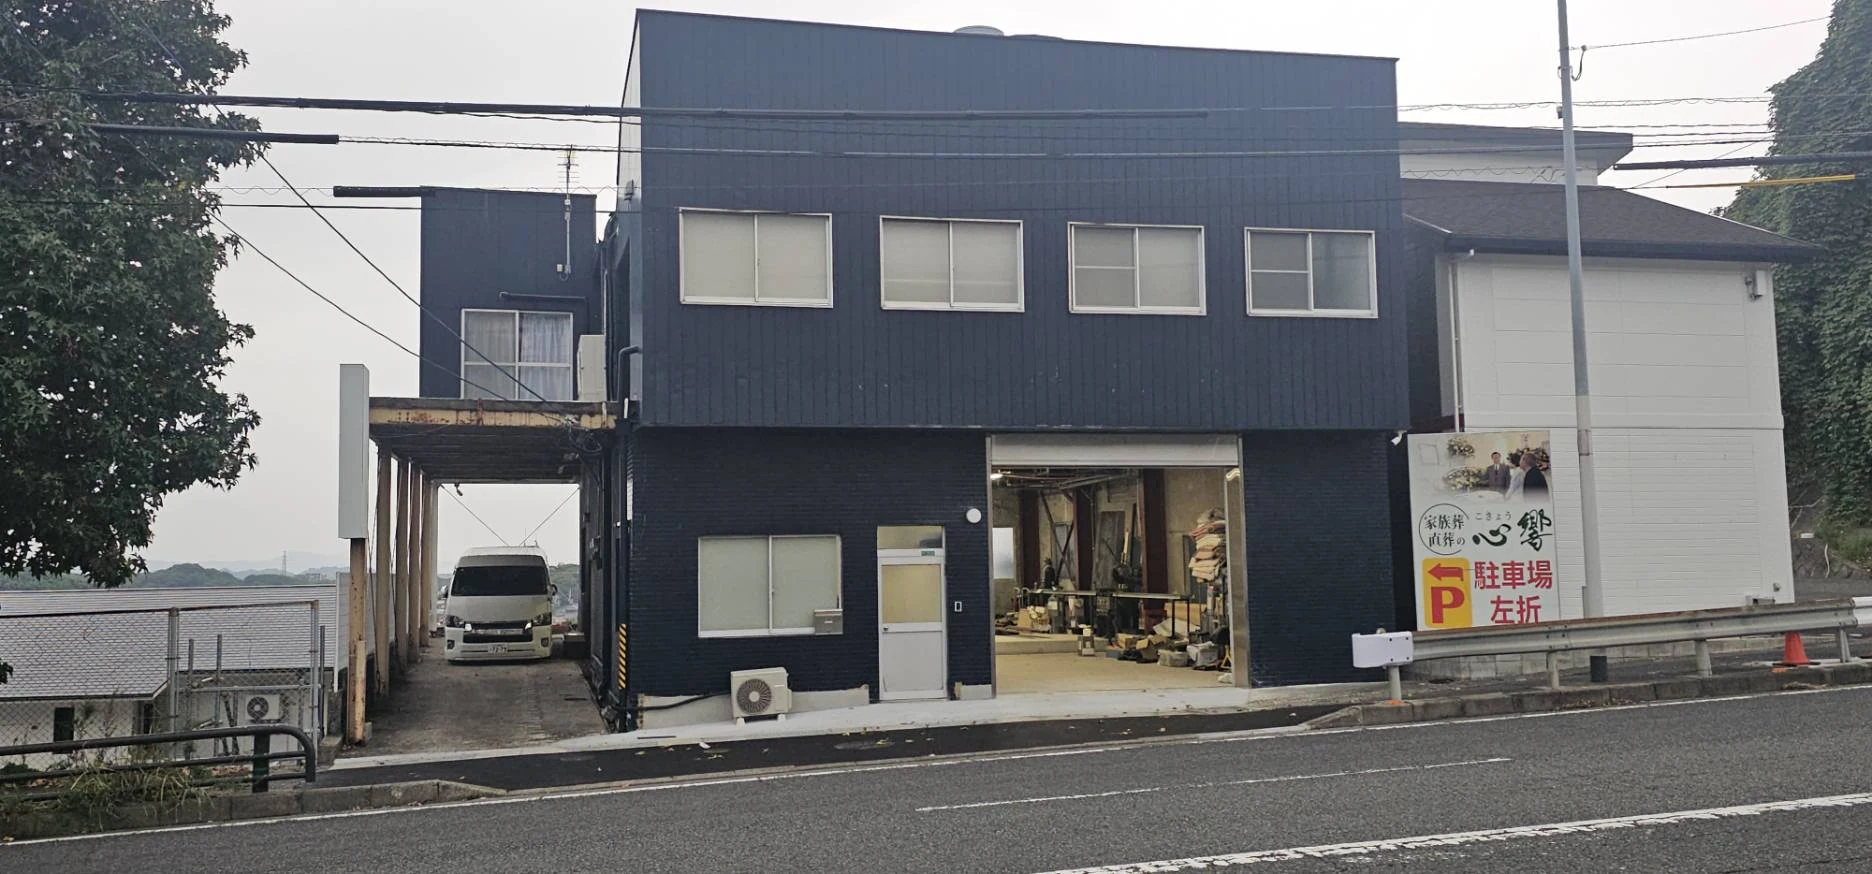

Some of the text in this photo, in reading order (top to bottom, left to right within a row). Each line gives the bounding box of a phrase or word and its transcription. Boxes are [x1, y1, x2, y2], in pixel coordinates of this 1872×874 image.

[1424, 514, 1465, 531] 家族葬
[1472, 508, 1553, 552] 心響
[1475, 511, 1512, 521] こきょう
[1428, 531, 1466, 548] 直葬の
[1474, 560, 1553, 590] 駐車場
[1431, 586, 1465, 624] P
[1490, 595, 1542, 625] 左折
